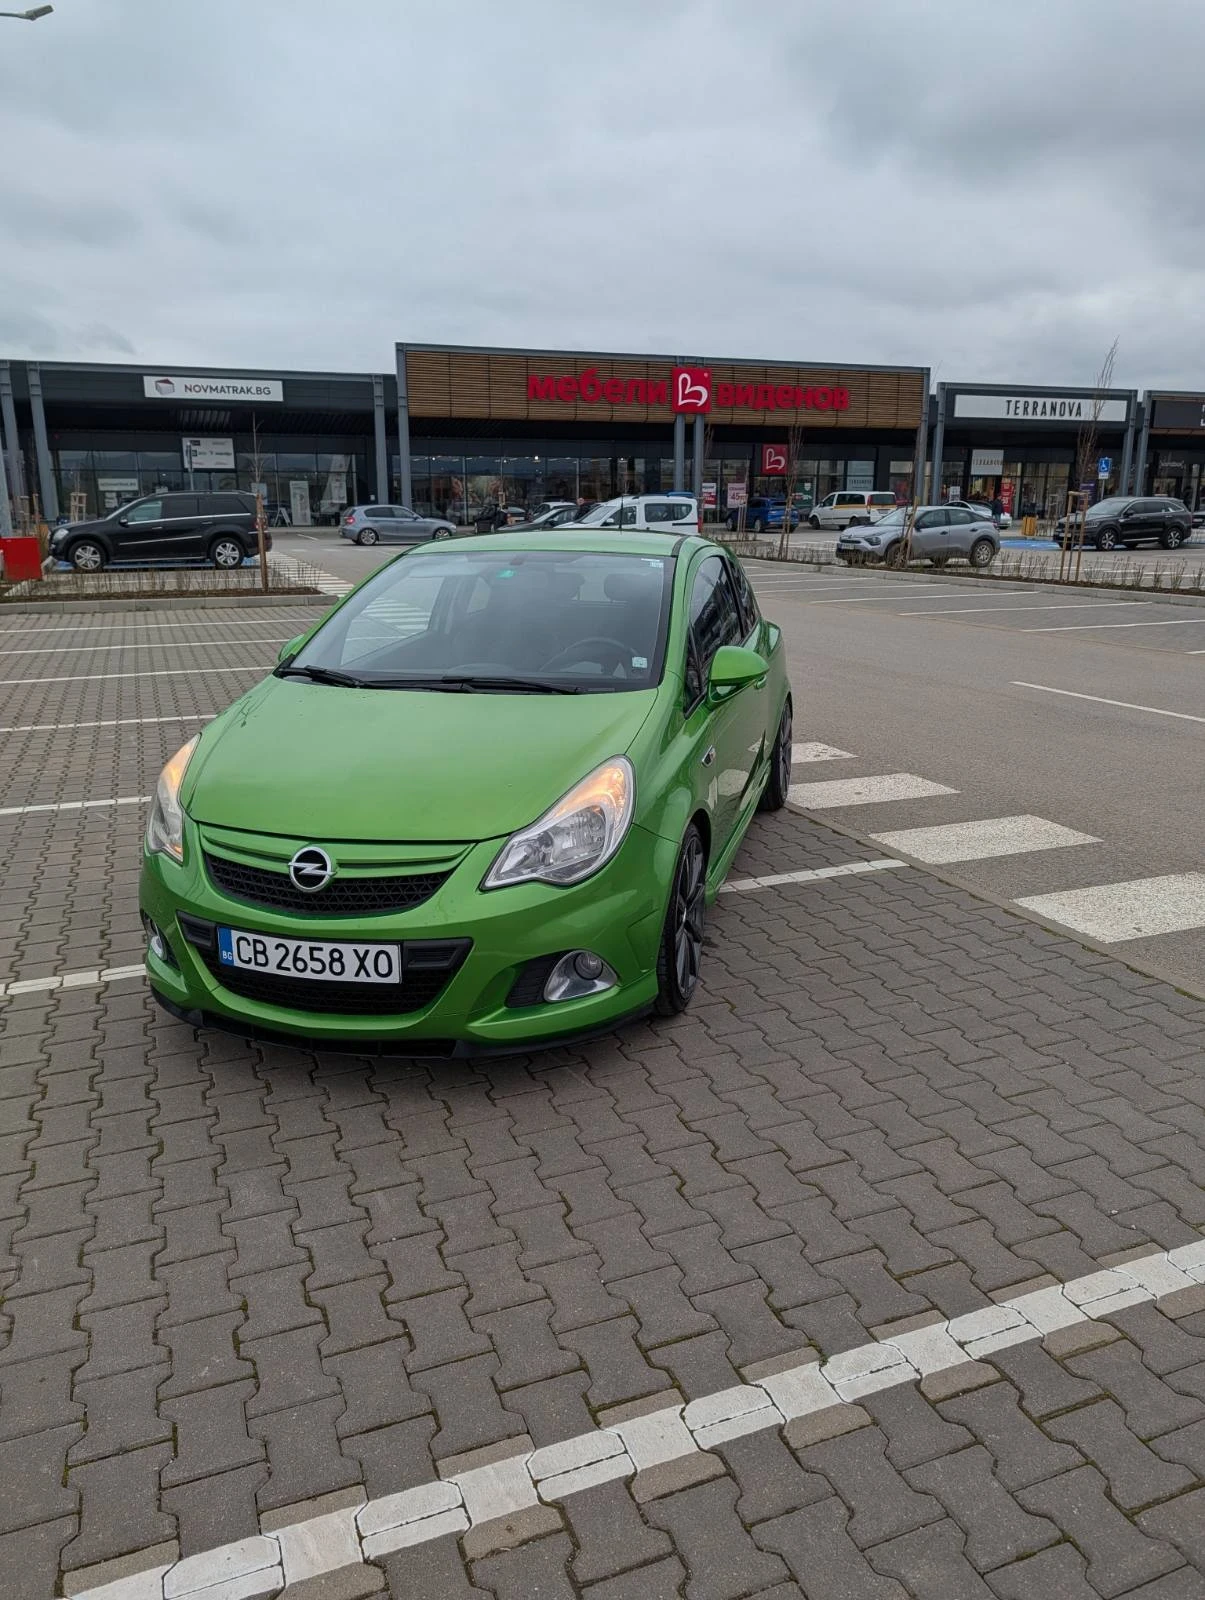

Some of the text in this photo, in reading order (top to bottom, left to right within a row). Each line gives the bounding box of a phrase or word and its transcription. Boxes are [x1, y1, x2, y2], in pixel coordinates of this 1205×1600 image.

[184, 384, 272, 395] NOVMATRAK.BG
[527, 366, 849, 411] мебели виденов
[1006, 399, 1082, 417] TERRANOVA
[222, 951, 233, 961] BG
[274, 943, 346, 977] 2658
